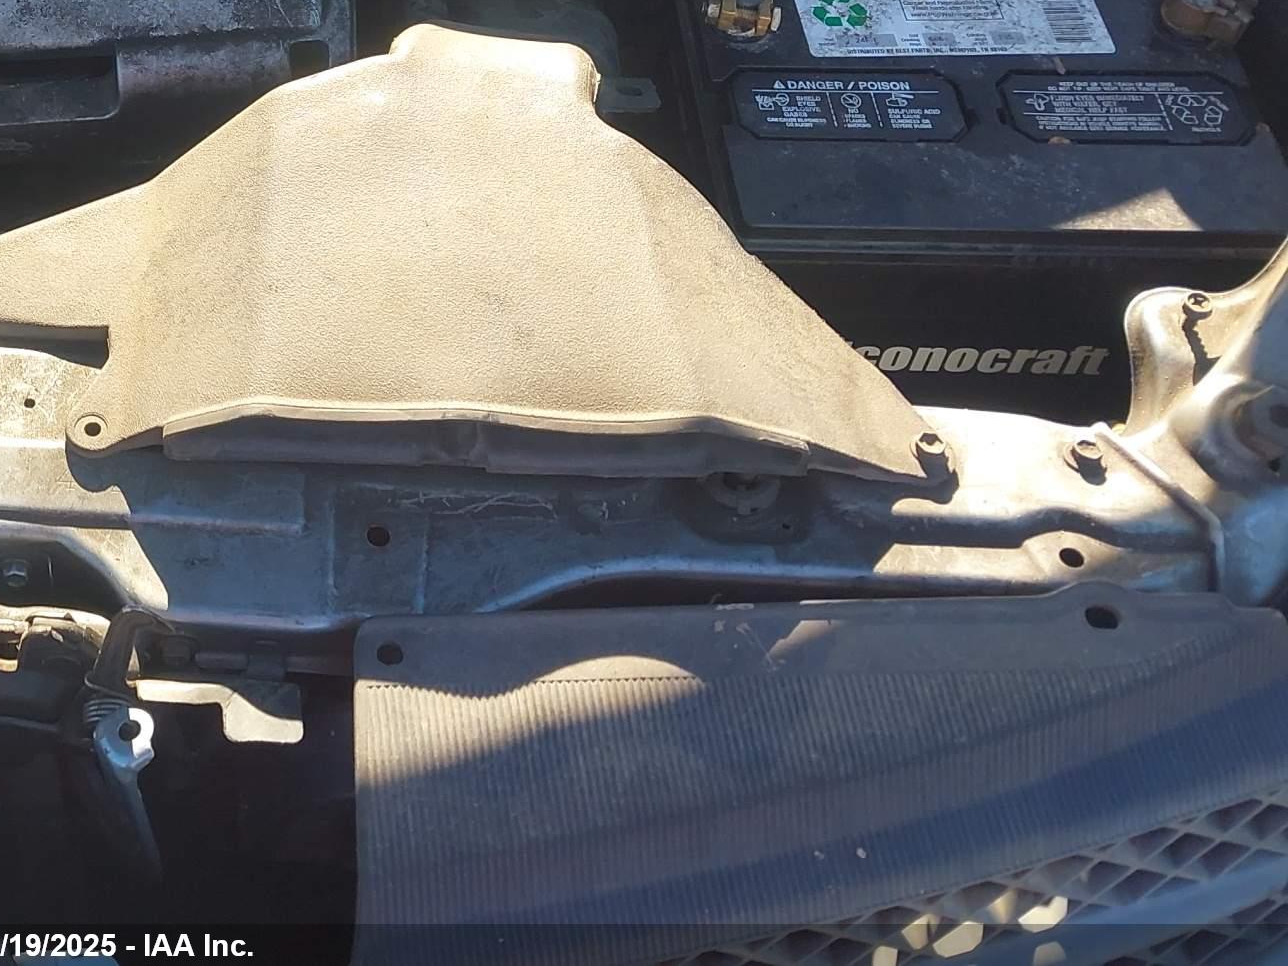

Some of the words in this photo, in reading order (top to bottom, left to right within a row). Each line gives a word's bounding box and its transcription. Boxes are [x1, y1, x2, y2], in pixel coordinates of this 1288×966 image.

[787, 81, 844, 90] DANGER
[857, 81, 910, 90] POISON
[846, 341, 1110, 375] conocraft
